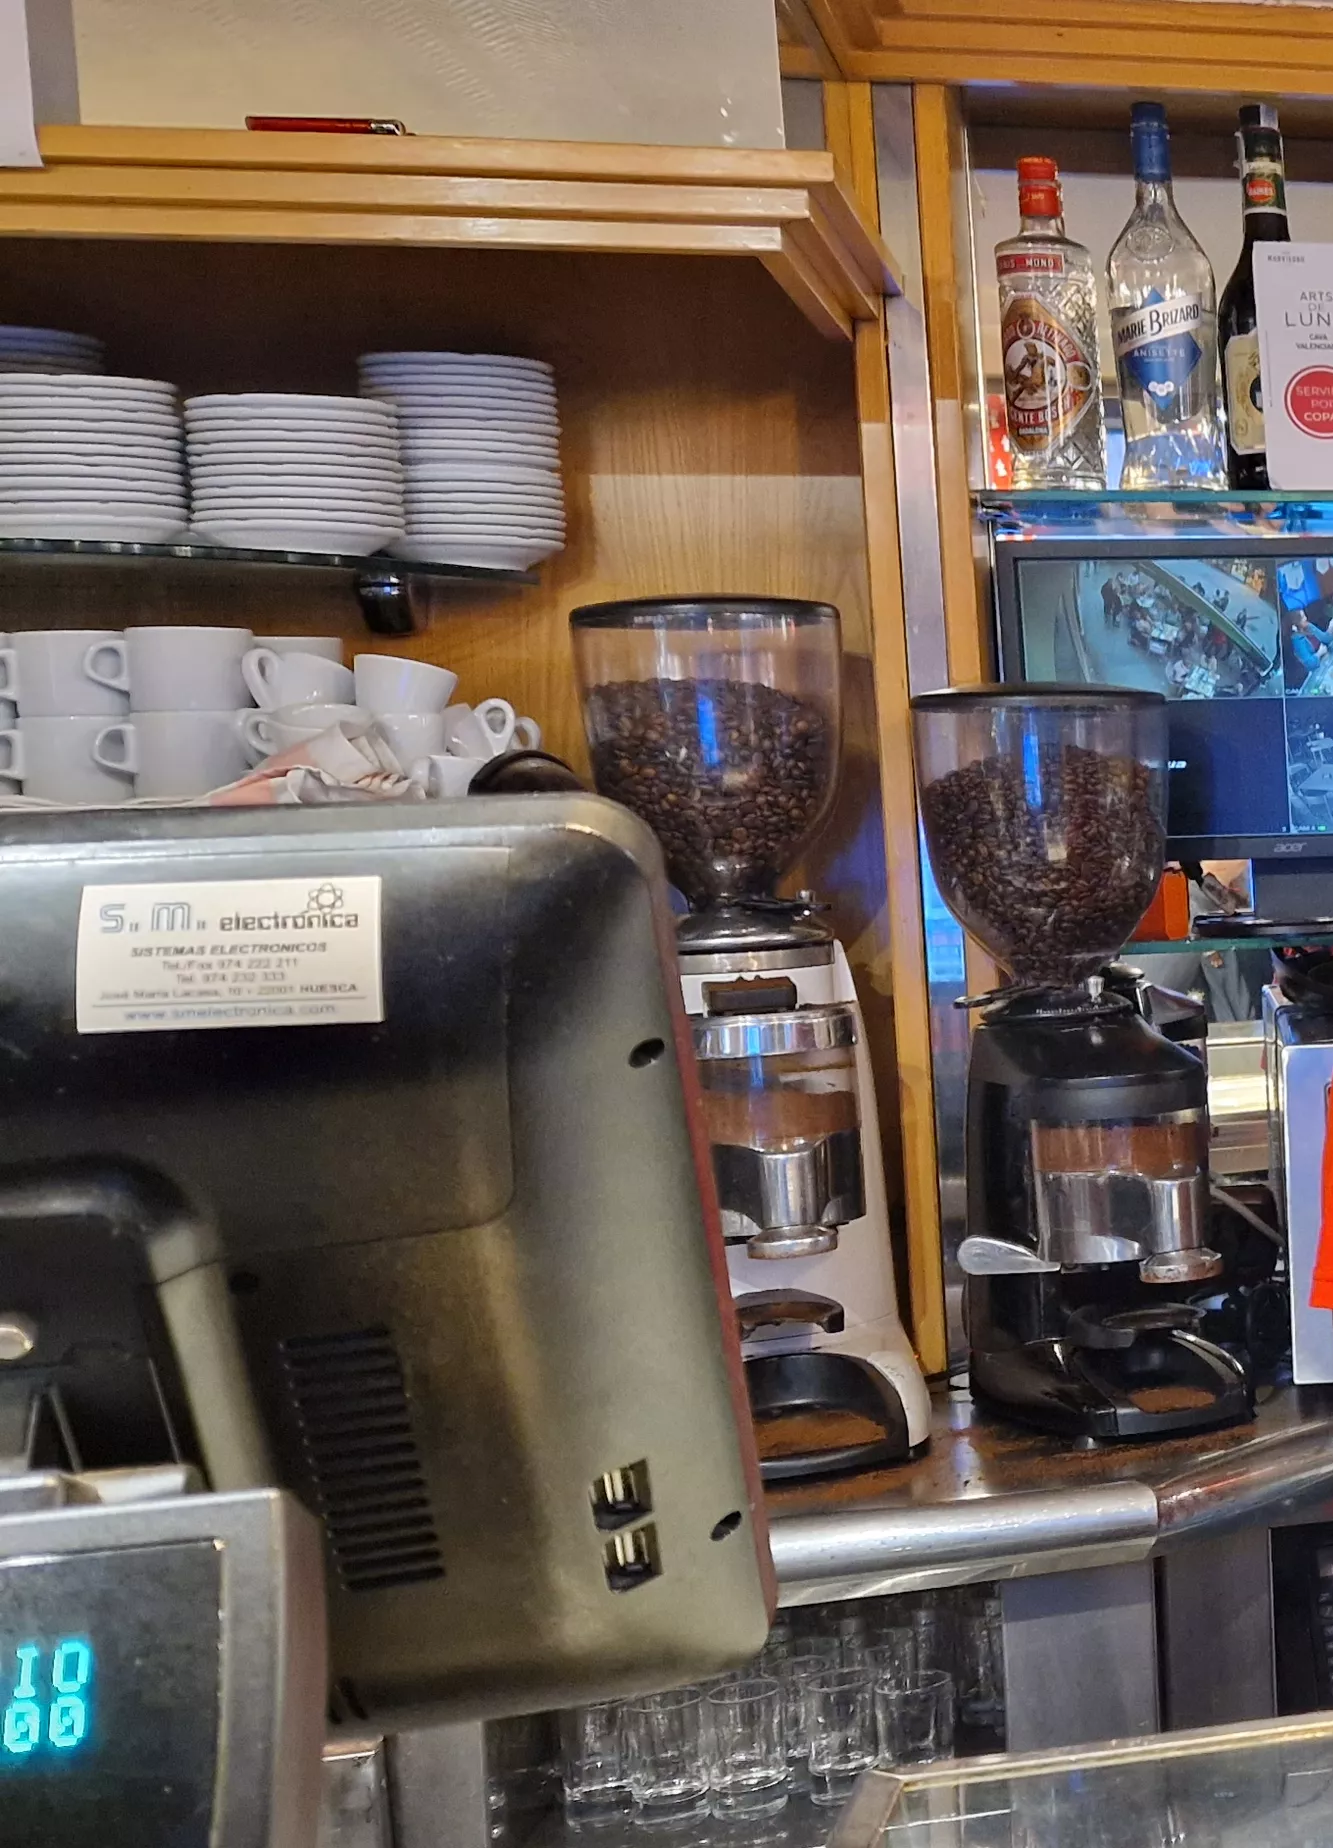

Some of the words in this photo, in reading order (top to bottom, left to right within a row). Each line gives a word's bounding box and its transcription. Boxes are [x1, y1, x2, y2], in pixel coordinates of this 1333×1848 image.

[1025, 257, 1054, 269] MONO
[1300, 291, 1333, 302] ARTS
[1308, 302, 1325, 312] DE
[1117, 318, 1148, 344] MARIE
[1149, 303, 1199, 337] BRIZARD
[1273, 842, 1308, 853] acer
[130, 945, 206, 957] SISTEMAS
